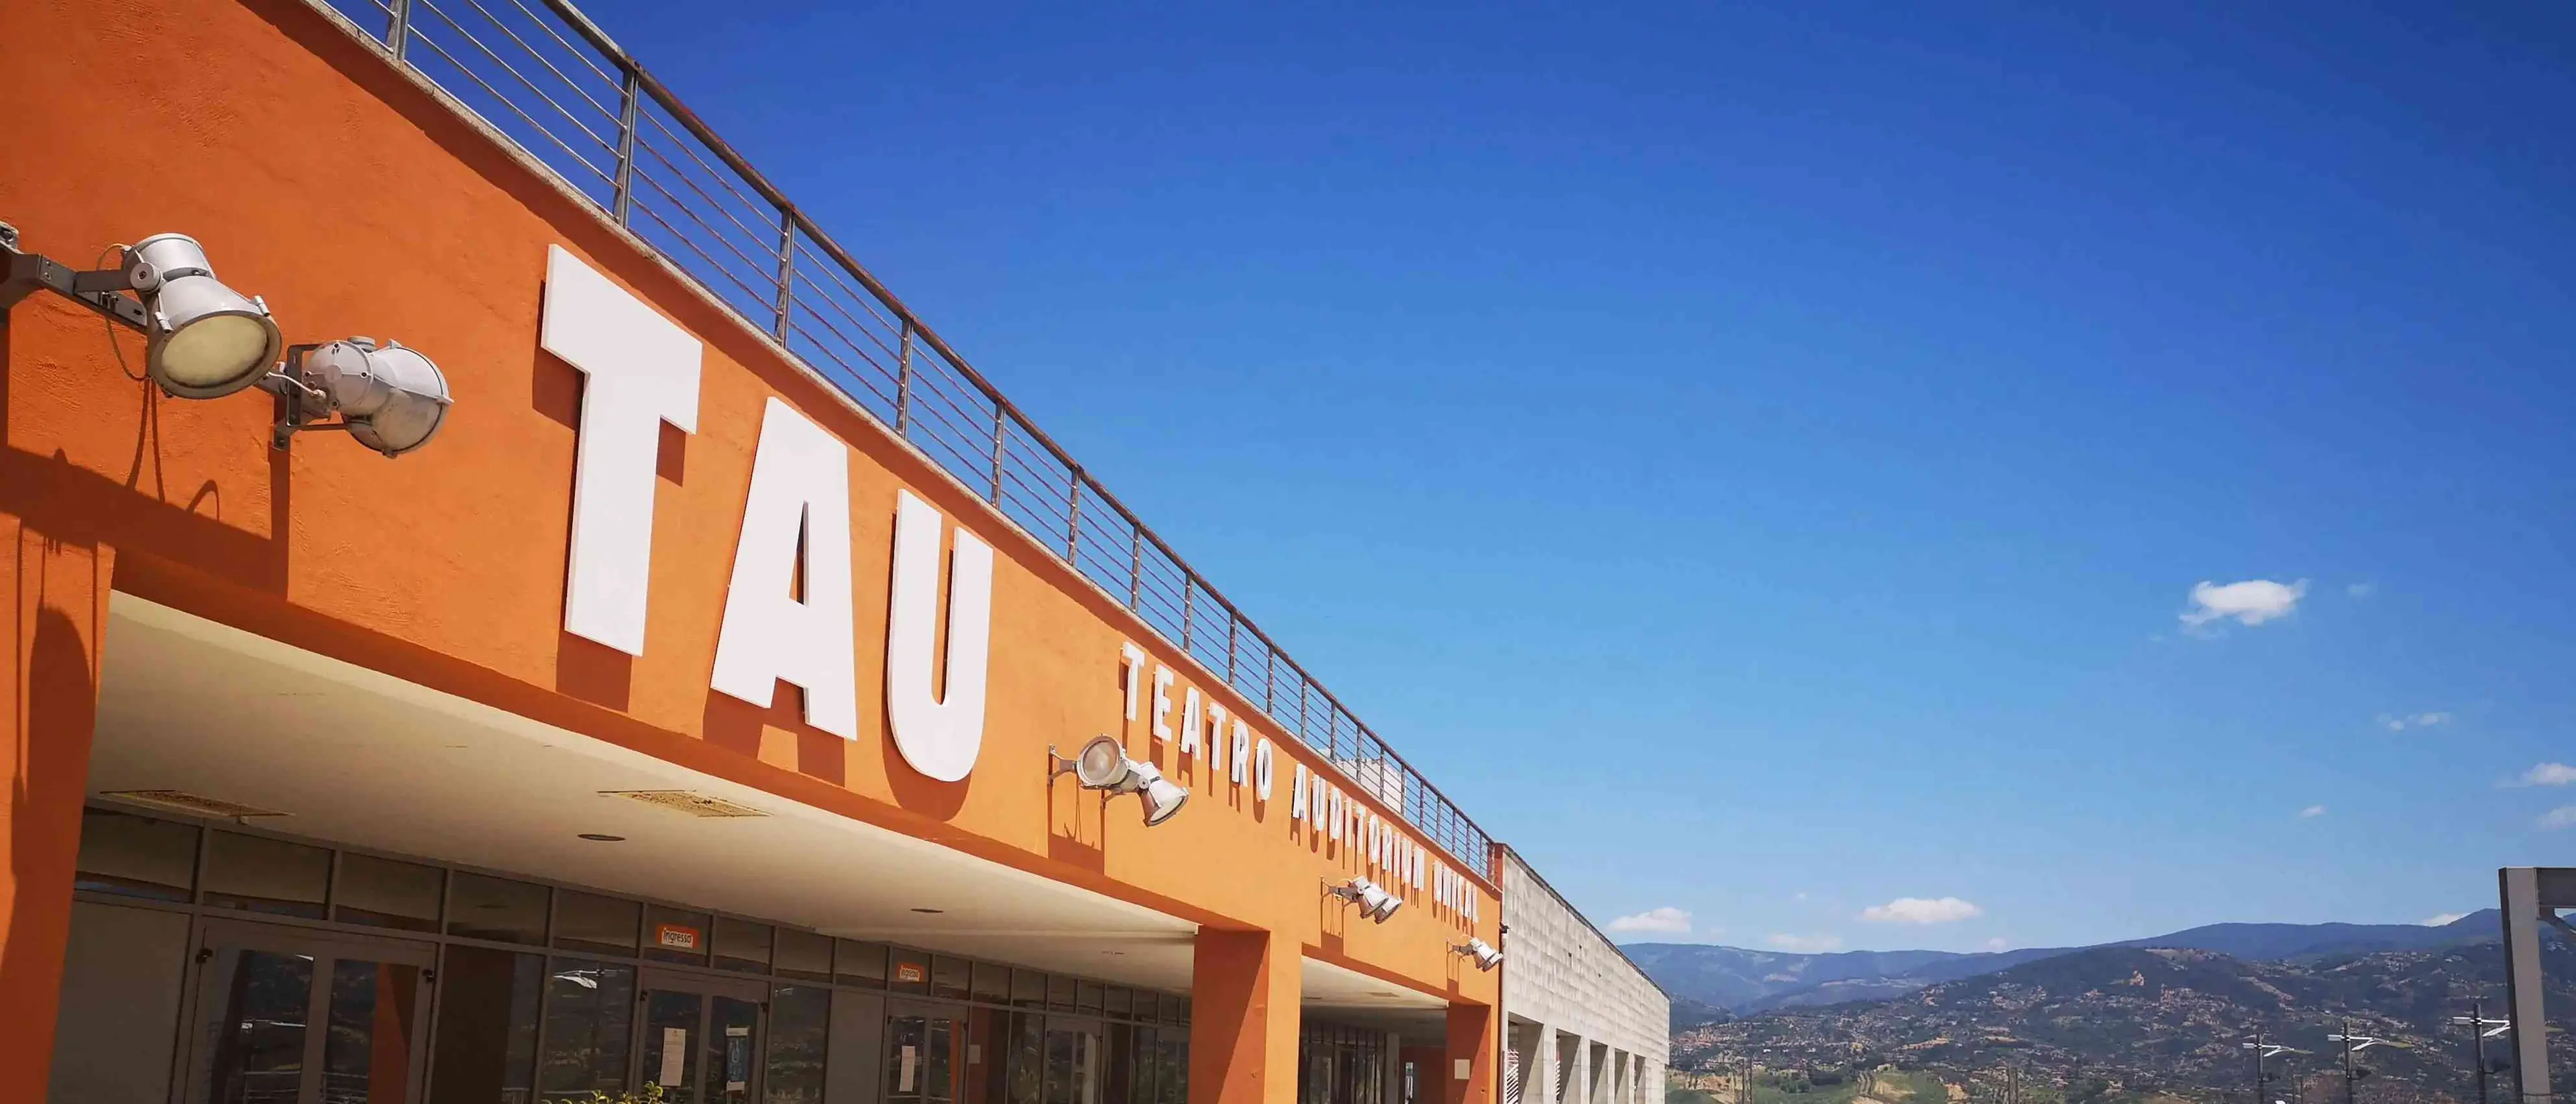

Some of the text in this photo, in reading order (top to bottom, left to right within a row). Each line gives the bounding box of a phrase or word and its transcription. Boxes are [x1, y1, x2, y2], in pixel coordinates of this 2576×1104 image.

[541, 244, 994, 782] TAU
[1122, 642, 1479, 923] TEATRO AUDITORIUM UNICAL
